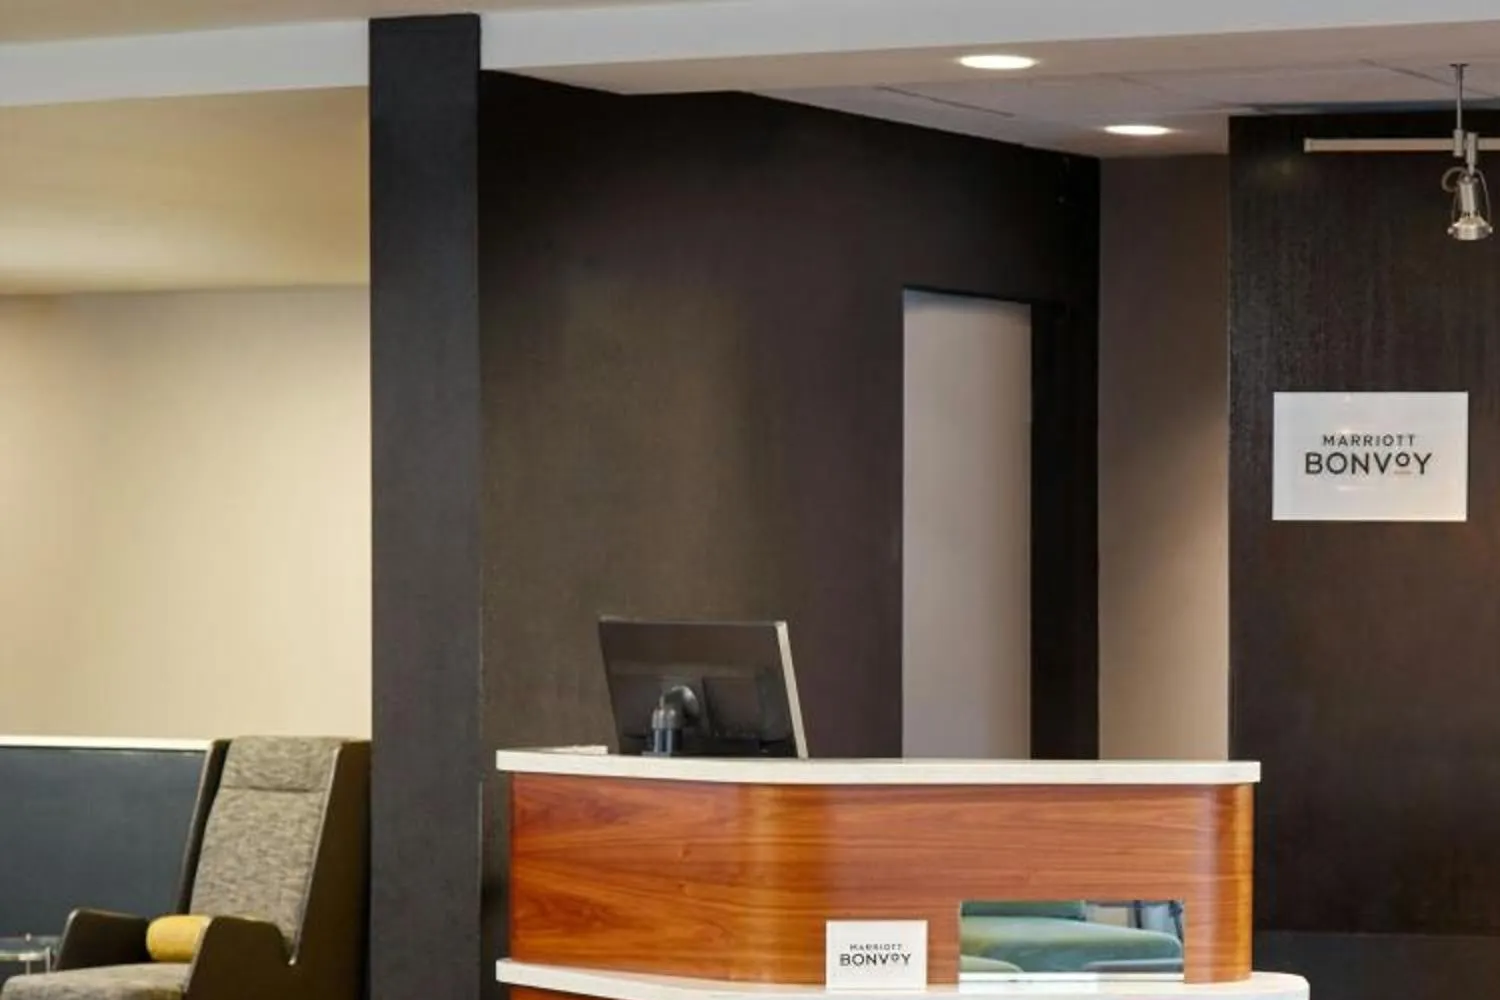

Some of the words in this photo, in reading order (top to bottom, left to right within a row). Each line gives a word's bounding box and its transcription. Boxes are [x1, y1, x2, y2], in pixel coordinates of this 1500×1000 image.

[1322, 434, 1415, 447] MARRIOTT
[1305, 452, 1432, 475] BONVOY
[839, 953, 911, 967] BONVOY
